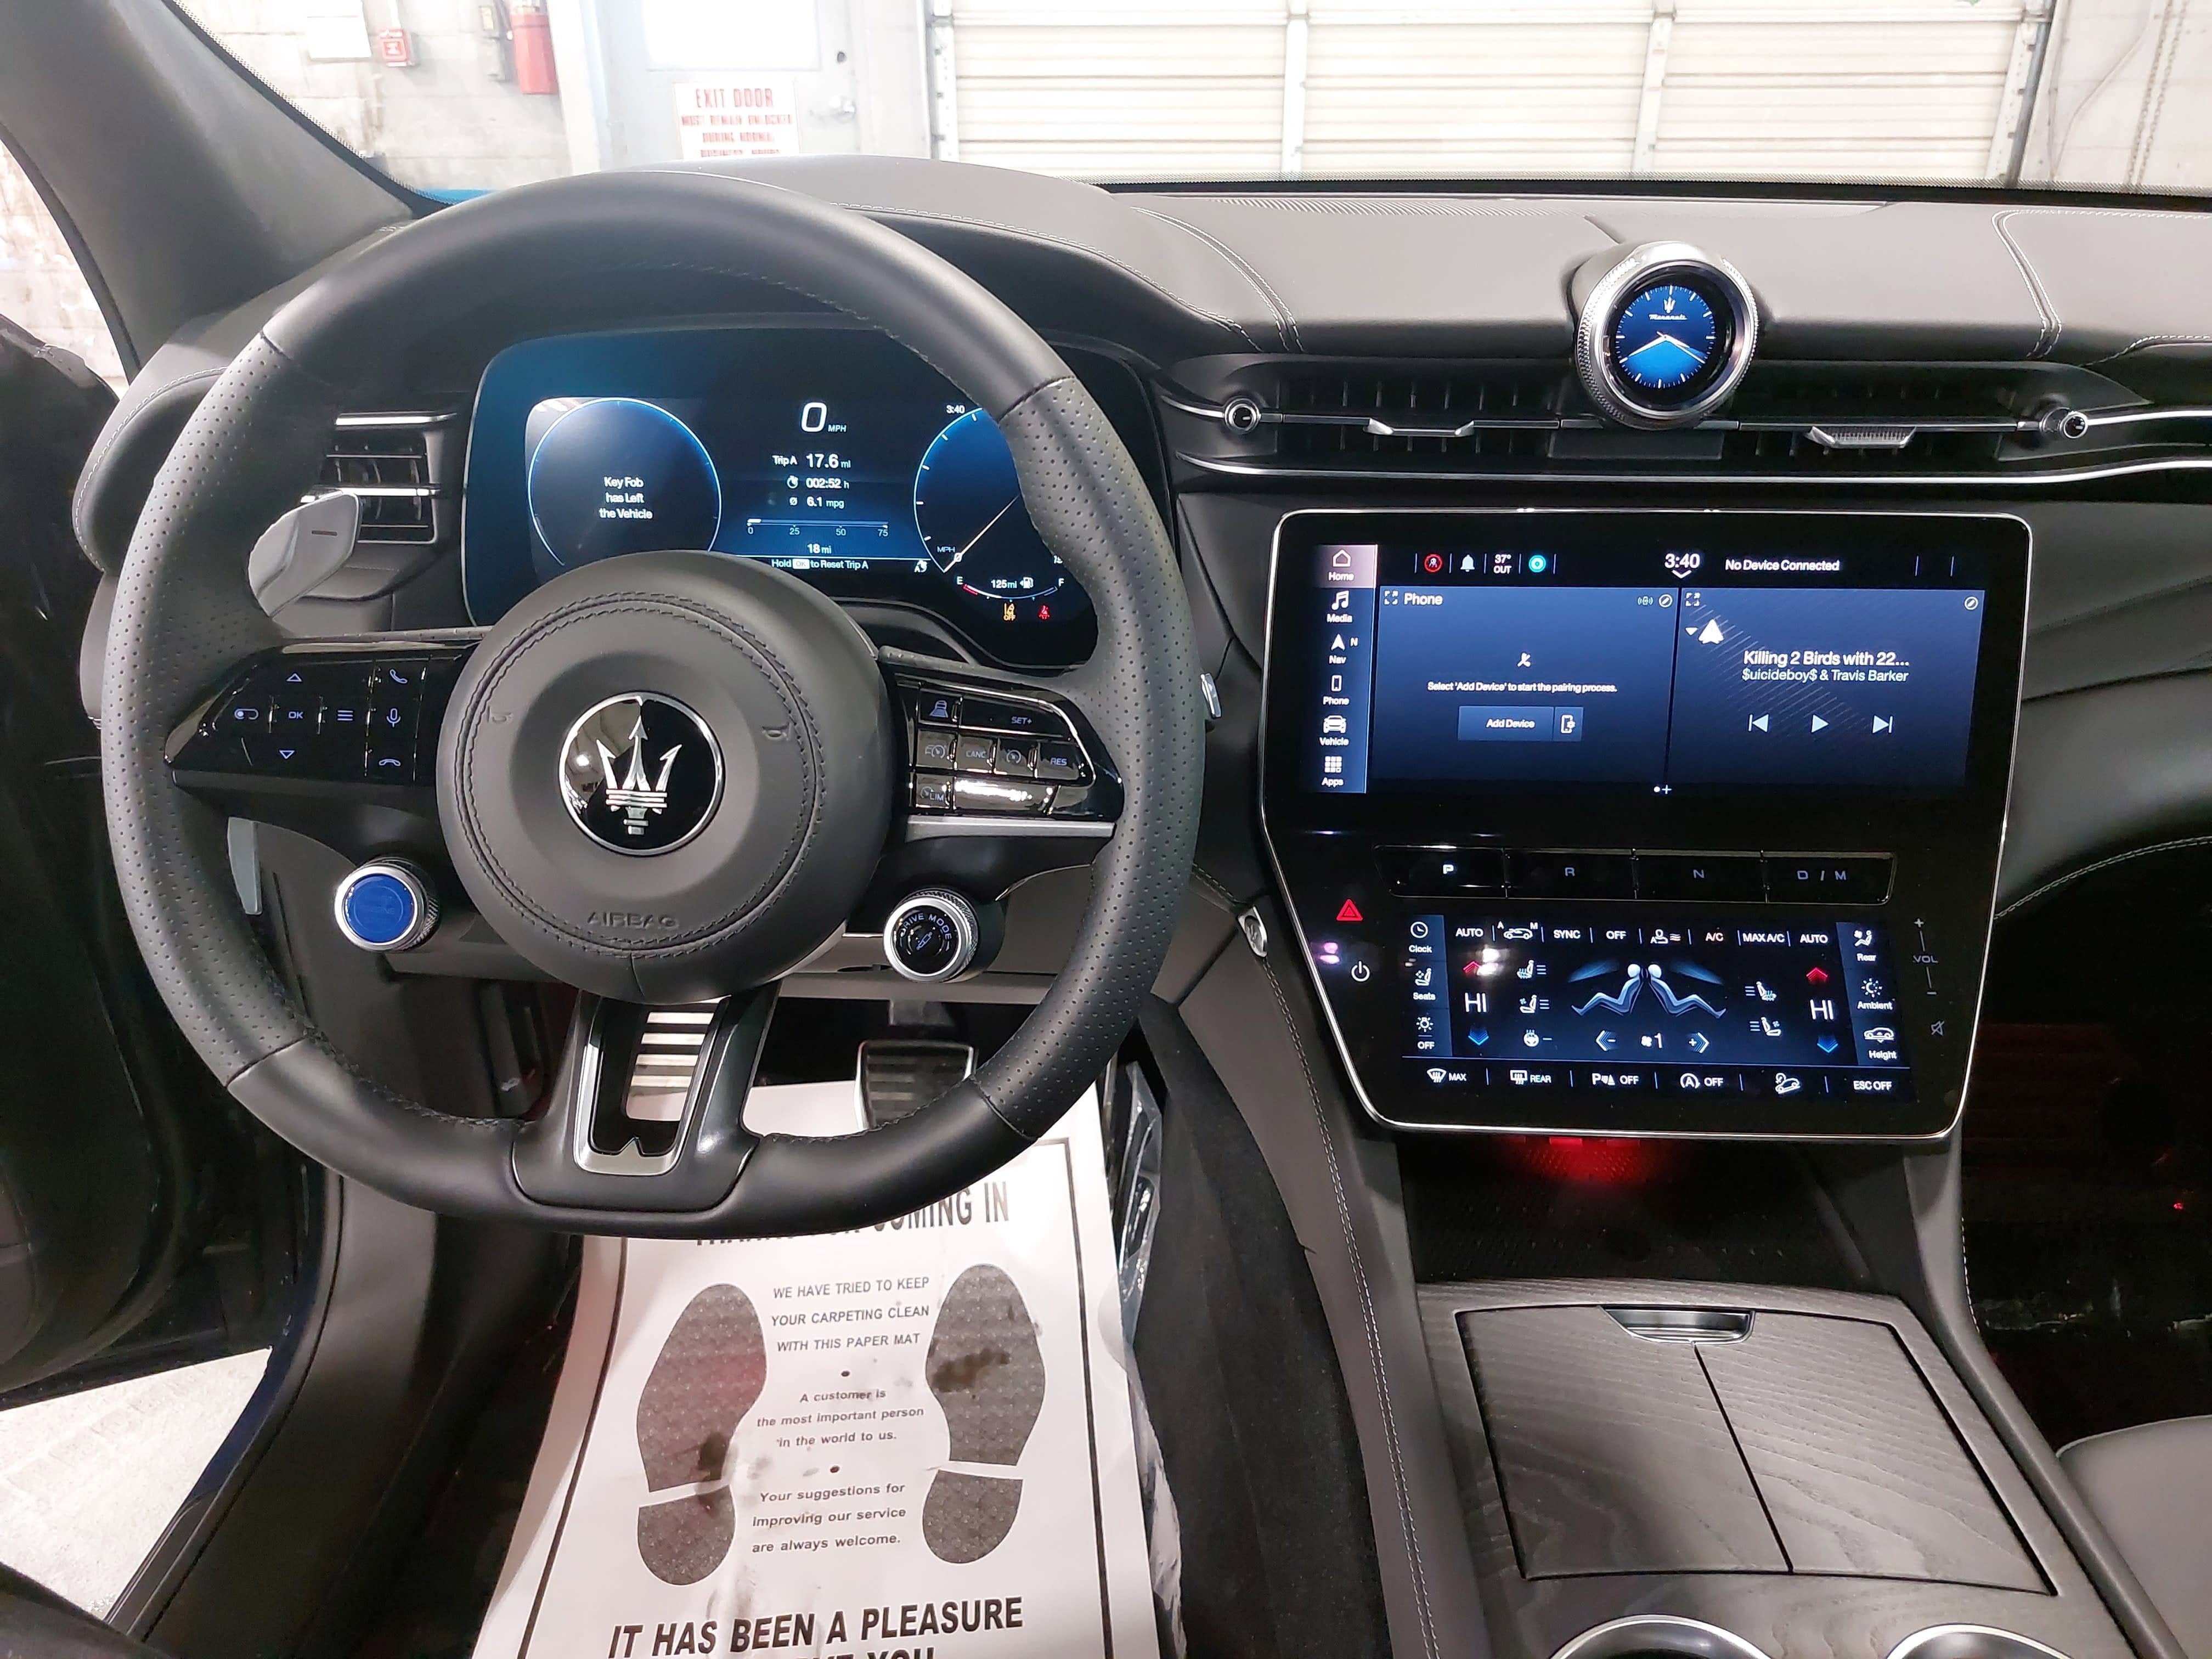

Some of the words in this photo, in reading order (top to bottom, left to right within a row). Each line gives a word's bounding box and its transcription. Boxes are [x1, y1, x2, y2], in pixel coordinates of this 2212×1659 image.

[696, 88, 725, 108] EXIT
[733, 88, 773, 108] DOOR
[946, 405, 965, 414] 3:40
[801, 402, 827, 432] 0
[772, 455, 789, 467] Trip
[789, 456, 798, 465] A
[806, 454, 839, 468] 17.6
[603, 477, 624, 489] Key
[625, 477, 644, 488] Fob
[806, 478, 842, 489] 002:52
[843, 481, 849, 489] h
[605, 493, 624, 503] has
[625, 493, 644, 503] Left
[806, 496, 822, 506] 6.1
[826, 499, 845, 509] mpg
[599, 508, 616, 518] the
[616, 508, 653, 518] Vehicle
[836, 528, 847, 536] 50
[807, 543, 820, 553] 18
[821, 545, 831, 554] mi
[771, 559, 792, 568] Hold
[810, 560, 819, 568] to
[820, 560, 843, 569] Reset
[844, 560, 861, 570] Trip
[861, 561, 868, 569] A
[1664, 553, 1700, 569] 3:40
[1725, 560, 1741, 571] No
[1743, 560, 1779, 571] Device
[1781, 560, 1839, 571] Connected
[1493, 565, 1512, 574] OUT
[957, 576, 963, 585] E
[1328, 572, 1355, 580] Home
[1058, 578, 1064, 586] F
[1404, 592, 1443, 606] Phone
[1327, 614, 1353, 623] Media
[1350, 638, 1358, 646] N
[1329, 655, 1346, 664] Nav
[1743, 651, 1787, 668] Killing
[1790, 652, 1800, 665] 2
[1803, 651, 1840, 665] Birds
[1843, 651, 1874, 666] with
[1876, 652, 1909, 666] 22...
[1742, 668, 1817, 682] $uicideboy$
[1820, 670, 1829, 681] &
[1831, 670, 1865, 681] Travis
[1868, 670, 1909, 681] Barker
[1427, 682, 1454, 691] Select
[1455, 682, 1475, 691] 'Add
[1476, 682, 1506, 691] Device'
[1517, 683, 1537, 691] start
[1537, 684, 1551, 692] the
[1552, 684, 1581, 693] pairing
[1582, 685, 1617, 693] process.
[1323, 696, 1350, 706] Phone
[1486, 719, 1504, 728] Add
[1505, 719, 1535, 728] Device
[1319, 737, 1349, 746] Vehicle
[1050, 757, 1067, 766] RES
[1322, 777, 1344, 787] Apps
[930, 793, 944, 802] LIM
[1443, 864, 1454, 874] P
[1565, 867, 1575, 877] R
[1693, 870, 1705, 878] N
[587, 911, 679, 929] AIRBAG
[900, 912, 925, 937] DRIVE
[929, 915, 952, 940] MODE
[1455, 928, 1483, 937] AUTO
[1554, 930, 1581, 939] SYNC
[1606, 931, 1627, 940] OFF
[1706, 933, 1724, 941] A/C
[1743, 933, 1766, 942] MAX
[1768, 934, 1785, 943] A/C
[1800, 934, 1828, 943] AUTO
[1413, 992, 1436, 1001] Seats
[1465, 992, 1487, 1012] HI
[1857, 1001, 1893, 1009] Ambient
[1810, 1000, 1834, 1019] HI
[1417, 1041, 1435, 1049] OFF
[1654, 1032, 1662, 1048] 1
[1869, 1050, 1897, 1060] Height
[1449, 1073, 1466, 1081] MAX
[1620, 1075, 1639, 1085] OFF
[1704, 1077, 1723, 1087] OFF
[1853, 1081, 1872, 1090] ESC
[1873, 1081, 1892, 1090] OFF
[984, 1181, 1009, 1222] IN
[774, 1287, 793, 1299] WE
[797, 1284, 831, 1297] HAVE
[836, 1282, 871, 1294] TRIED
[876, 1279, 892, 1291] TO
[898, 1277, 929, 1289] KEEP
[772, 1314, 805, 1326] YOUR
[811, 1308, 882, 1323] CARPETING
[888, 1306, 929, 1318] CLEAN
[777, 1341, 808, 1351] WITH
[814, 1339, 841, 1350] THIS
[847, 1335, 889, 1347] PAPER
[894, 1333, 921, 1344] MAT
[800, 1394, 809, 1402] A
[814, 1391, 872, 1402] customer
[876, 1389, 885, 1398] is
[758, 1416, 776, 1427] the
[781, 1415, 812, 1425] most
[817, 1410, 876, 1424] important
[882, 1408, 924, 1420] person
[796, 1435, 815, 1446] the
[821, 1432, 855, 1443] world
[861, 1432, 873, 1441] to
[760, 1492, 792, 1502] Your
[797, 1484, 880, 1500] suggestions
[886, 1483, 905, 1493] for
[753, 1513, 822, 1528] improving
[828, 1513, 851, 1522] our
[856, 1508, 906, 1520] service
[752, 1543, 774, 1553] are
[781, 1539, 828, 1552] always
[835, 1535, 900, 1547] welcome.
[608, 1624, 642, 1658] IT
[655, 1621, 716, 1655] HAS
[730, 1613, 814, 1651] BEEN
[826, 1612, 848, 1645] A
[861, 1596, 1024, 1640] PLEASURE
